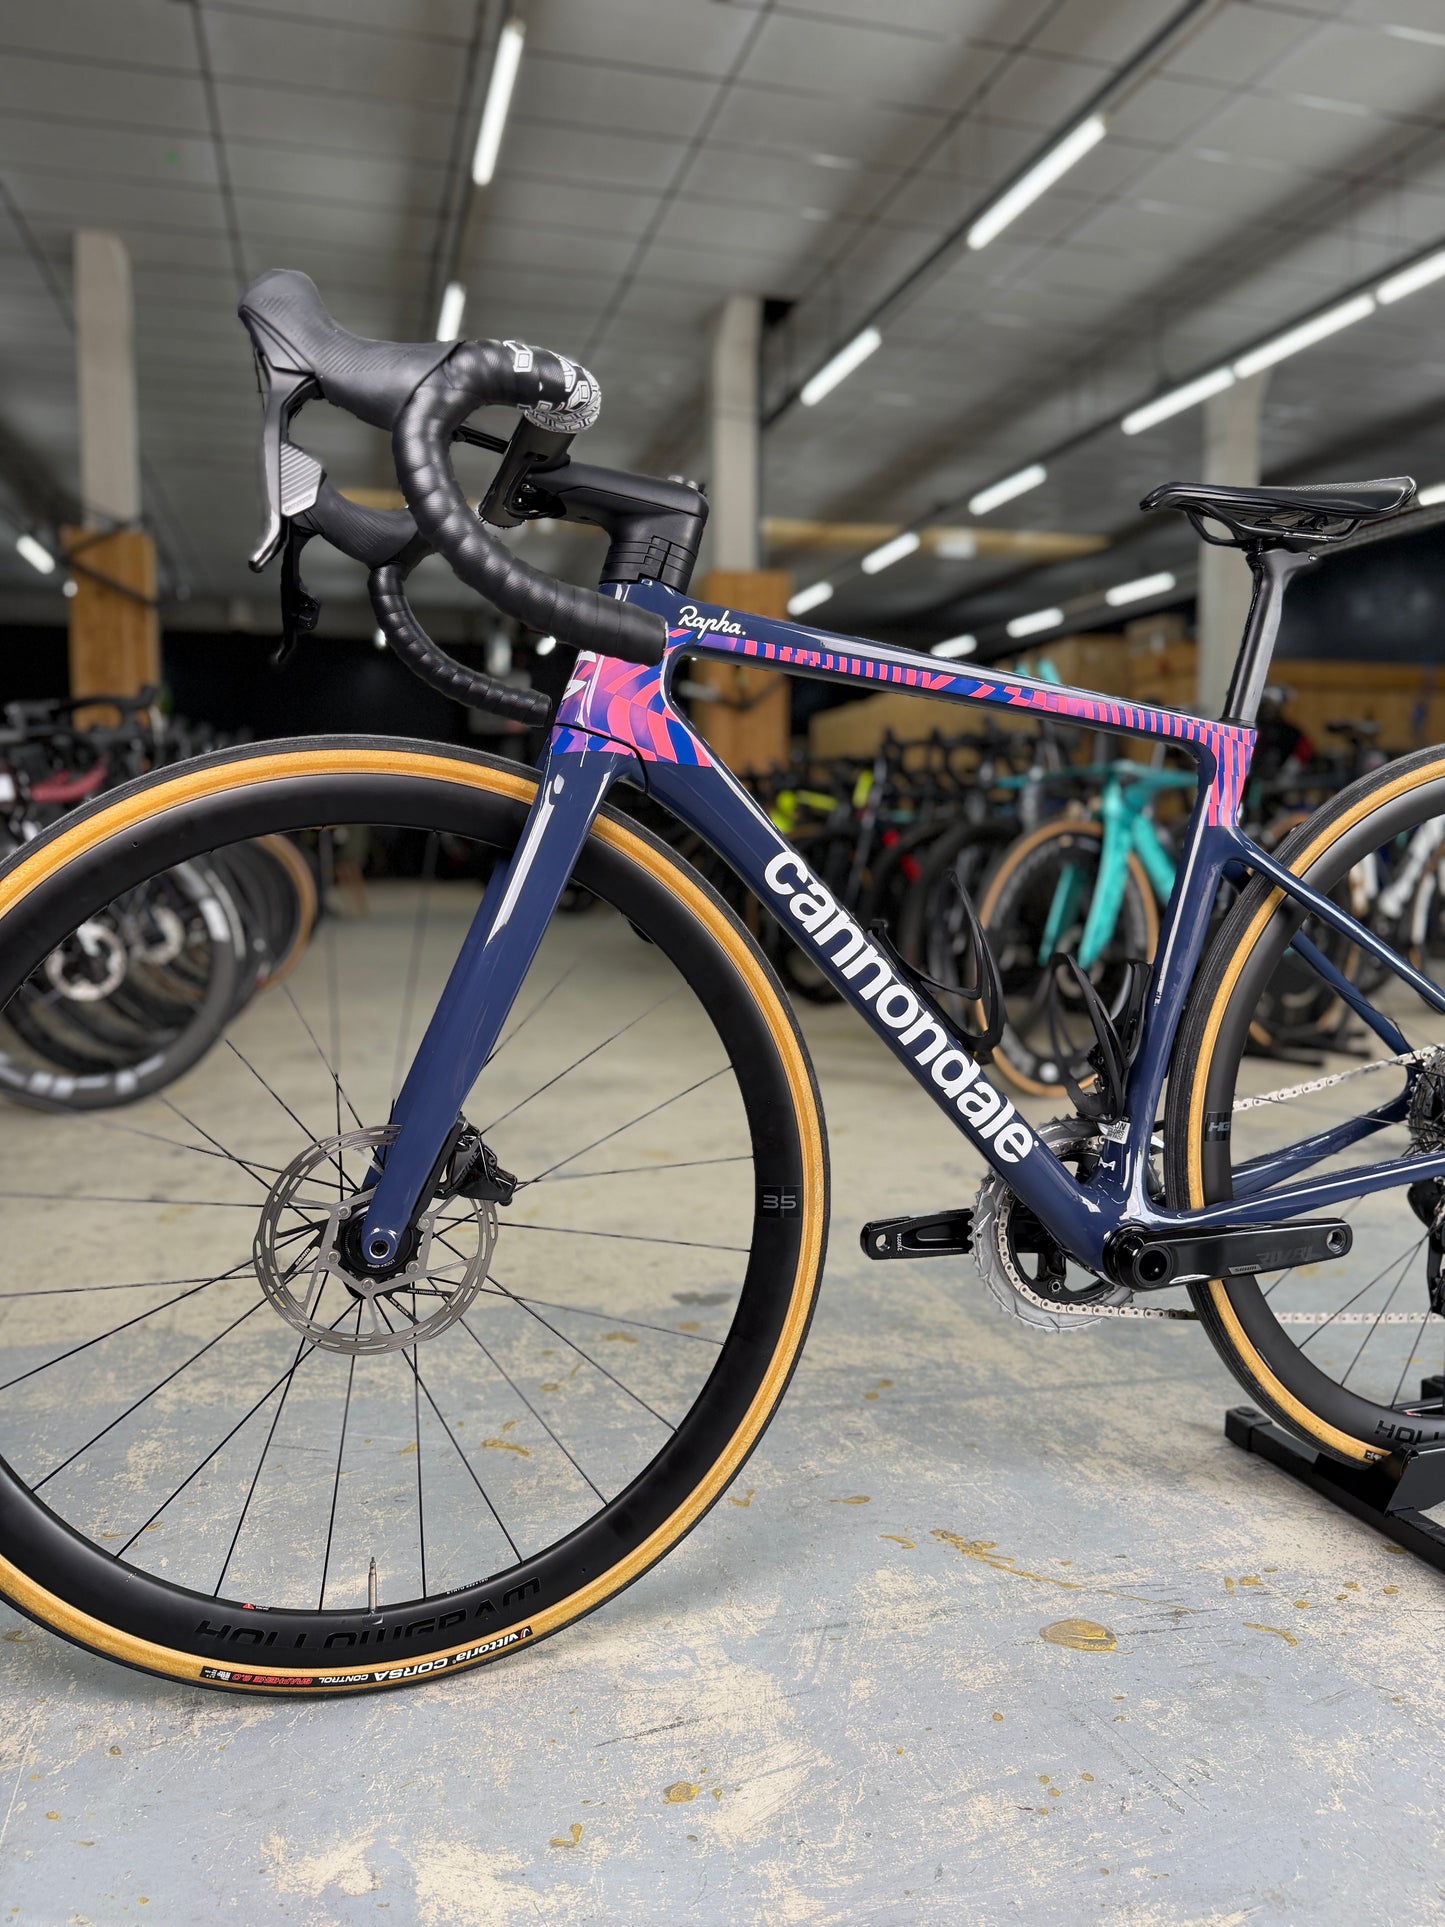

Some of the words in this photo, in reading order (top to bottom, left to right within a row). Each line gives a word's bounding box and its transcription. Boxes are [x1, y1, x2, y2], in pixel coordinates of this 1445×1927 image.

[764, 851, 1034, 1163] cannondale
[762, 1194, 797, 1210] 35
[374, 1657, 448, 1682] CORSA
[231, 1673, 252, 1683] 2.0
[318, 1673, 369, 1684] CONTROL
